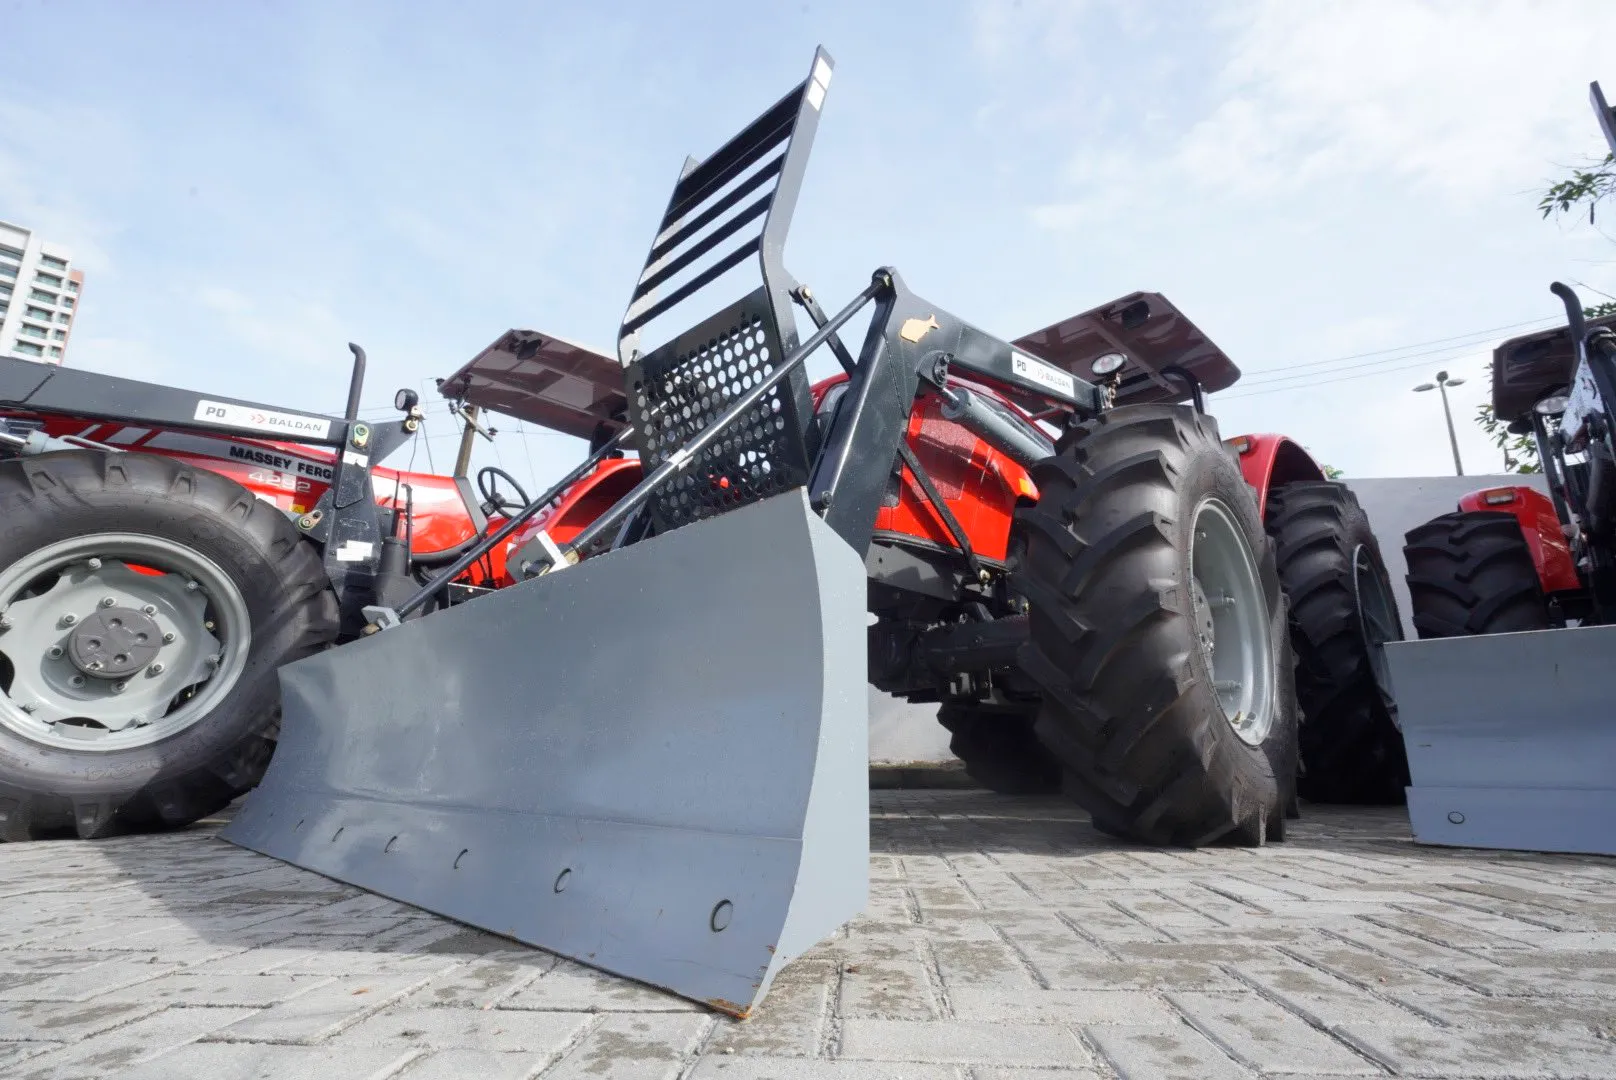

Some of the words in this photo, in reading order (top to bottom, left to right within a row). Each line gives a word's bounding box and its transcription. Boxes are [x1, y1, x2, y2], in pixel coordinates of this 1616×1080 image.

[1017, 359, 1027, 372] PD
[205, 406, 227, 418] PD
[268, 417, 322, 432] BALDAN
[230, 446, 292, 470] MASSEY
